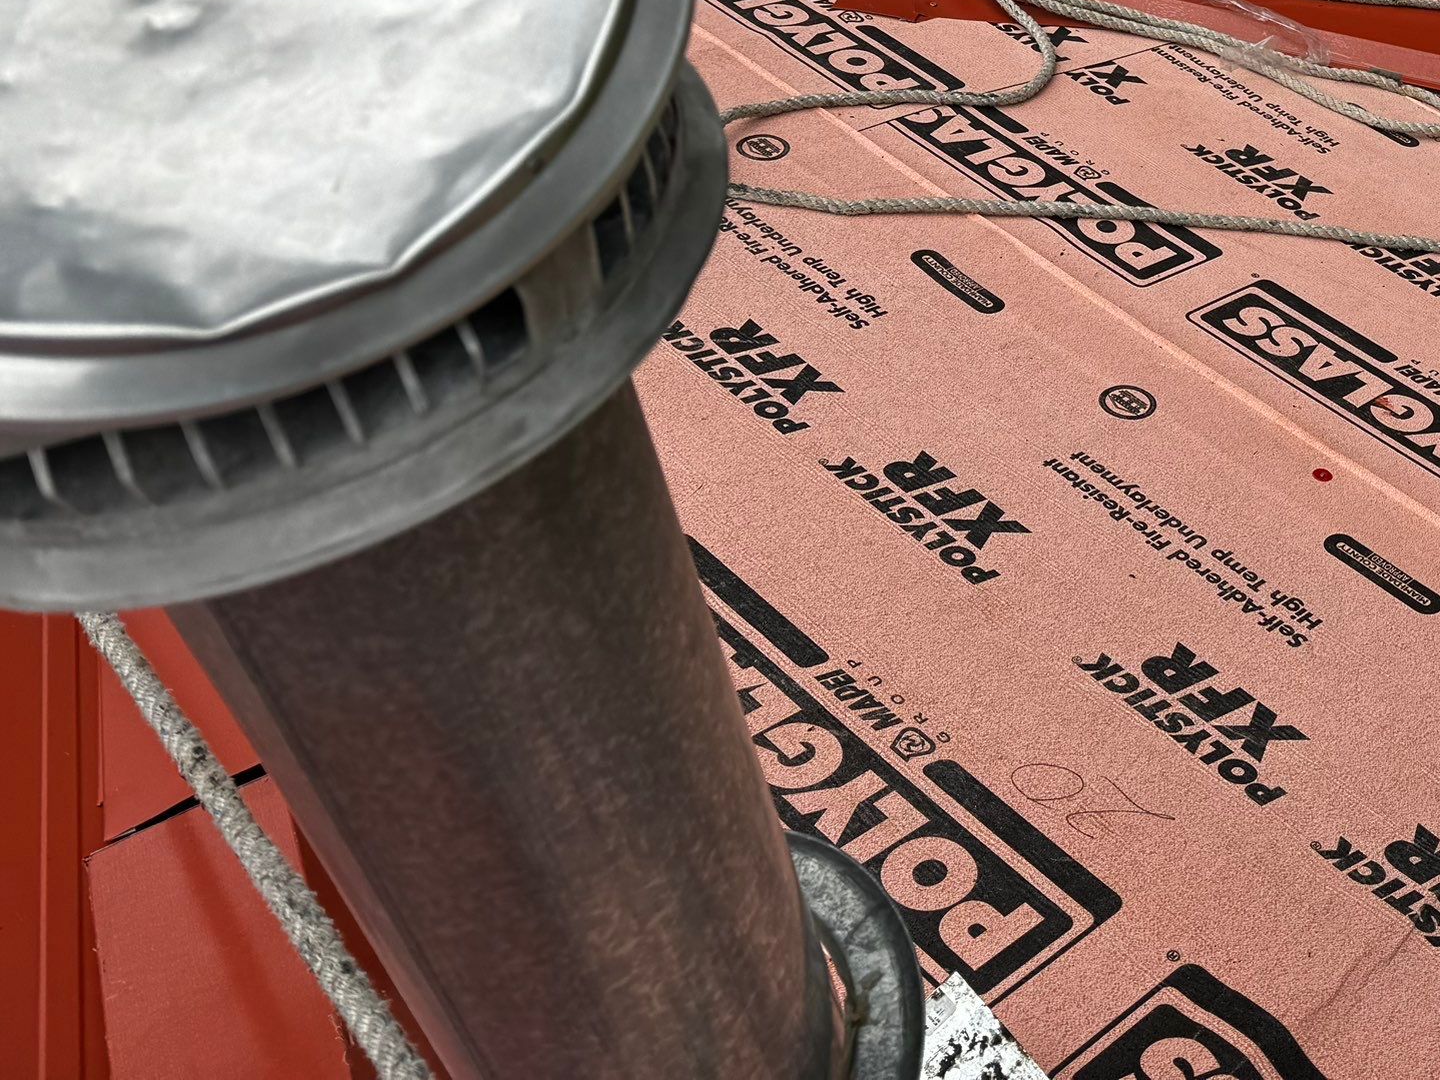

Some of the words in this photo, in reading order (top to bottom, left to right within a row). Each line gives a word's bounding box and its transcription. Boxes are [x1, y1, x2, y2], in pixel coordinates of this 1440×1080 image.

[1150, 45, 1243, 103] Fire-Resistant
[1168, 43, 1263, 101] Underlayment
[1238, 97, 1331, 156] Self-Adhered
[1265, 93, 1312, 127] Temp
[1306, 123, 1341, 148] High
[1022, 135, 1081, 166] MAPEI
[1226, 142, 1334, 201] XFR
[1185, 143, 1321, 222] POLYSTICK
[760, 255, 870, 331] Self-Adhered
[803, 256, 847, 288] Temp
[846, 288, 888, 318] High
[663, 320, 811, 435] POLYSTICK
[709, 318, 846, 406] XFR
[829, 456, 1001, 585] POLYSTICK
[883, 450, 1033, 551] XFR
[1042, 457, 1172, 552] Fire-Resistant
[1069, 450, 1208, 552] Underlayment
[1211, 547, 1267, 593] Temp
[1337, 542, 1378, 571] COUNTY
[1375, 566, 1430, 606] MIAMI-DADE
[1166, 548, 1311, 649] Self-Adhered
[1270, 589, 1324, 631] High
[813, 668, 903, 733] MAPEI
[1081, 652, 1287, 807] POLYSTICK
[1140, 641, 1311, 763] XFR
